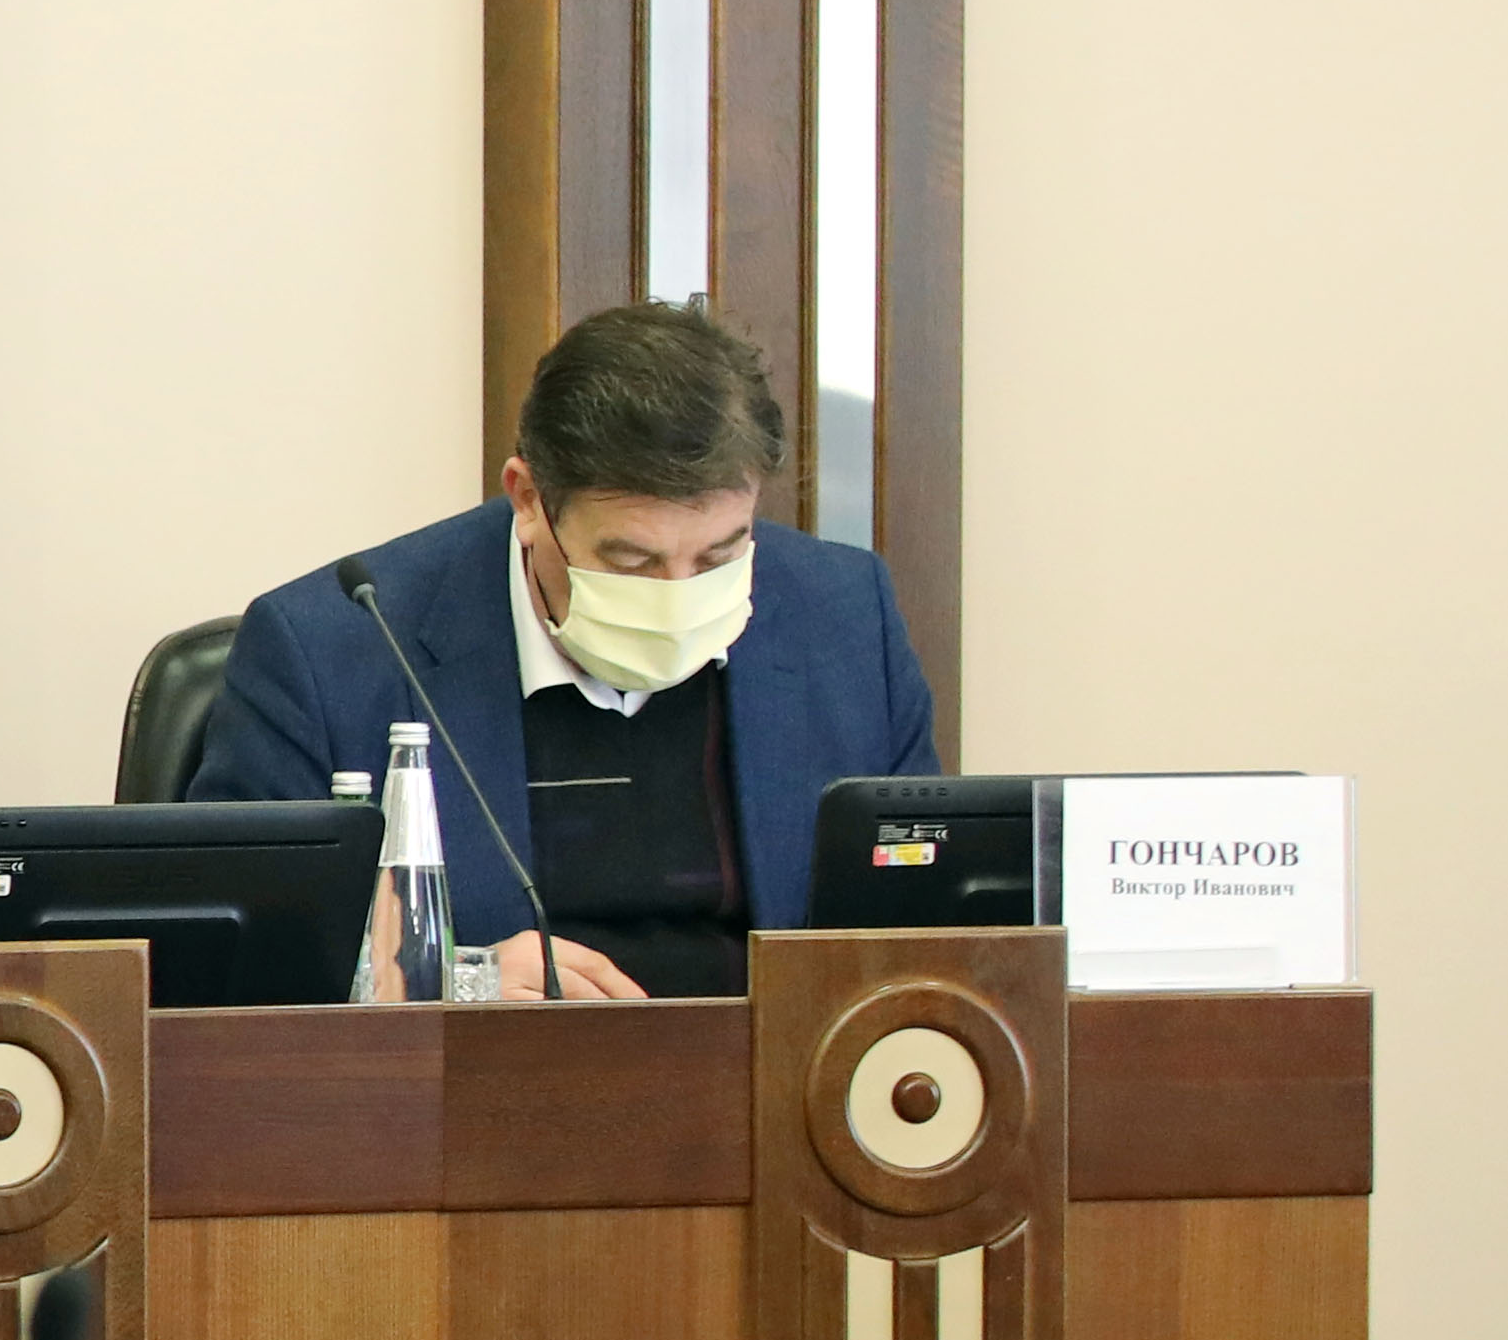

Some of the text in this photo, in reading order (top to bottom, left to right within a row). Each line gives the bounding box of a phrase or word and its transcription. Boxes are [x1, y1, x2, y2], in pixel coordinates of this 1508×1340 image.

[1108, 839, 1300, 867] ГОНЧАРОВ
[1111, 876, 1296, 900] Виктор Иванович
